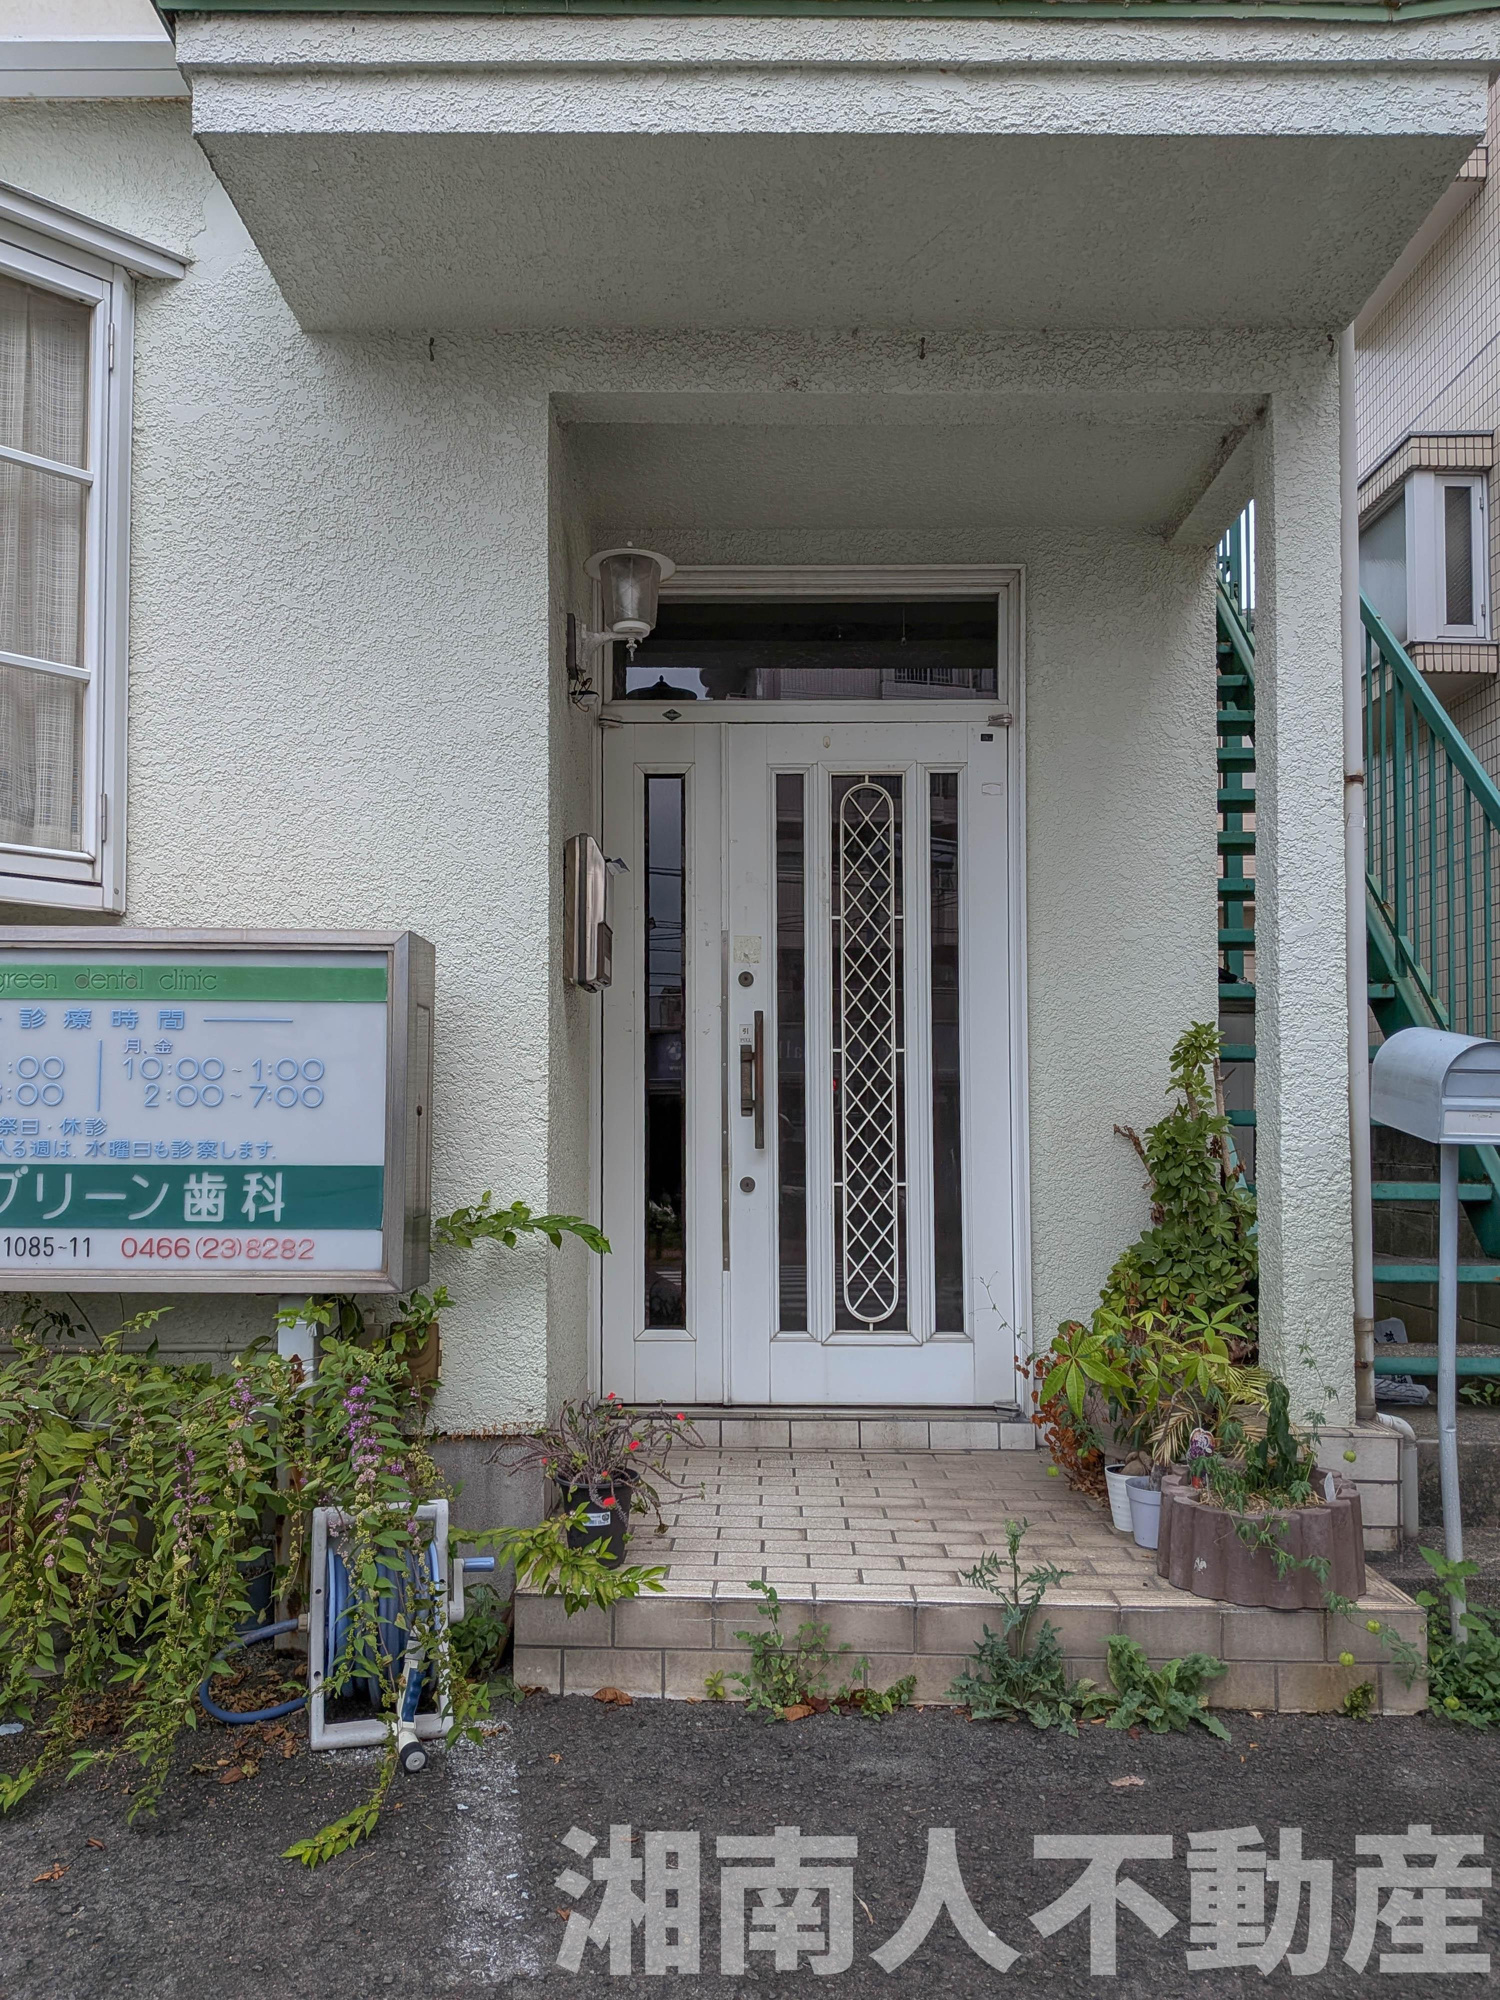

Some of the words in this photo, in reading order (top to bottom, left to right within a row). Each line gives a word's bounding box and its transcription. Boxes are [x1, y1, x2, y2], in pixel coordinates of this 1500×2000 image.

[74, 968, 144, 989] dental
[159, 968, 217, 990] clinic
[18, 1006, 185, 1030] 診療時間
[120, 1236, 315, 1260] 0466(23)8282
